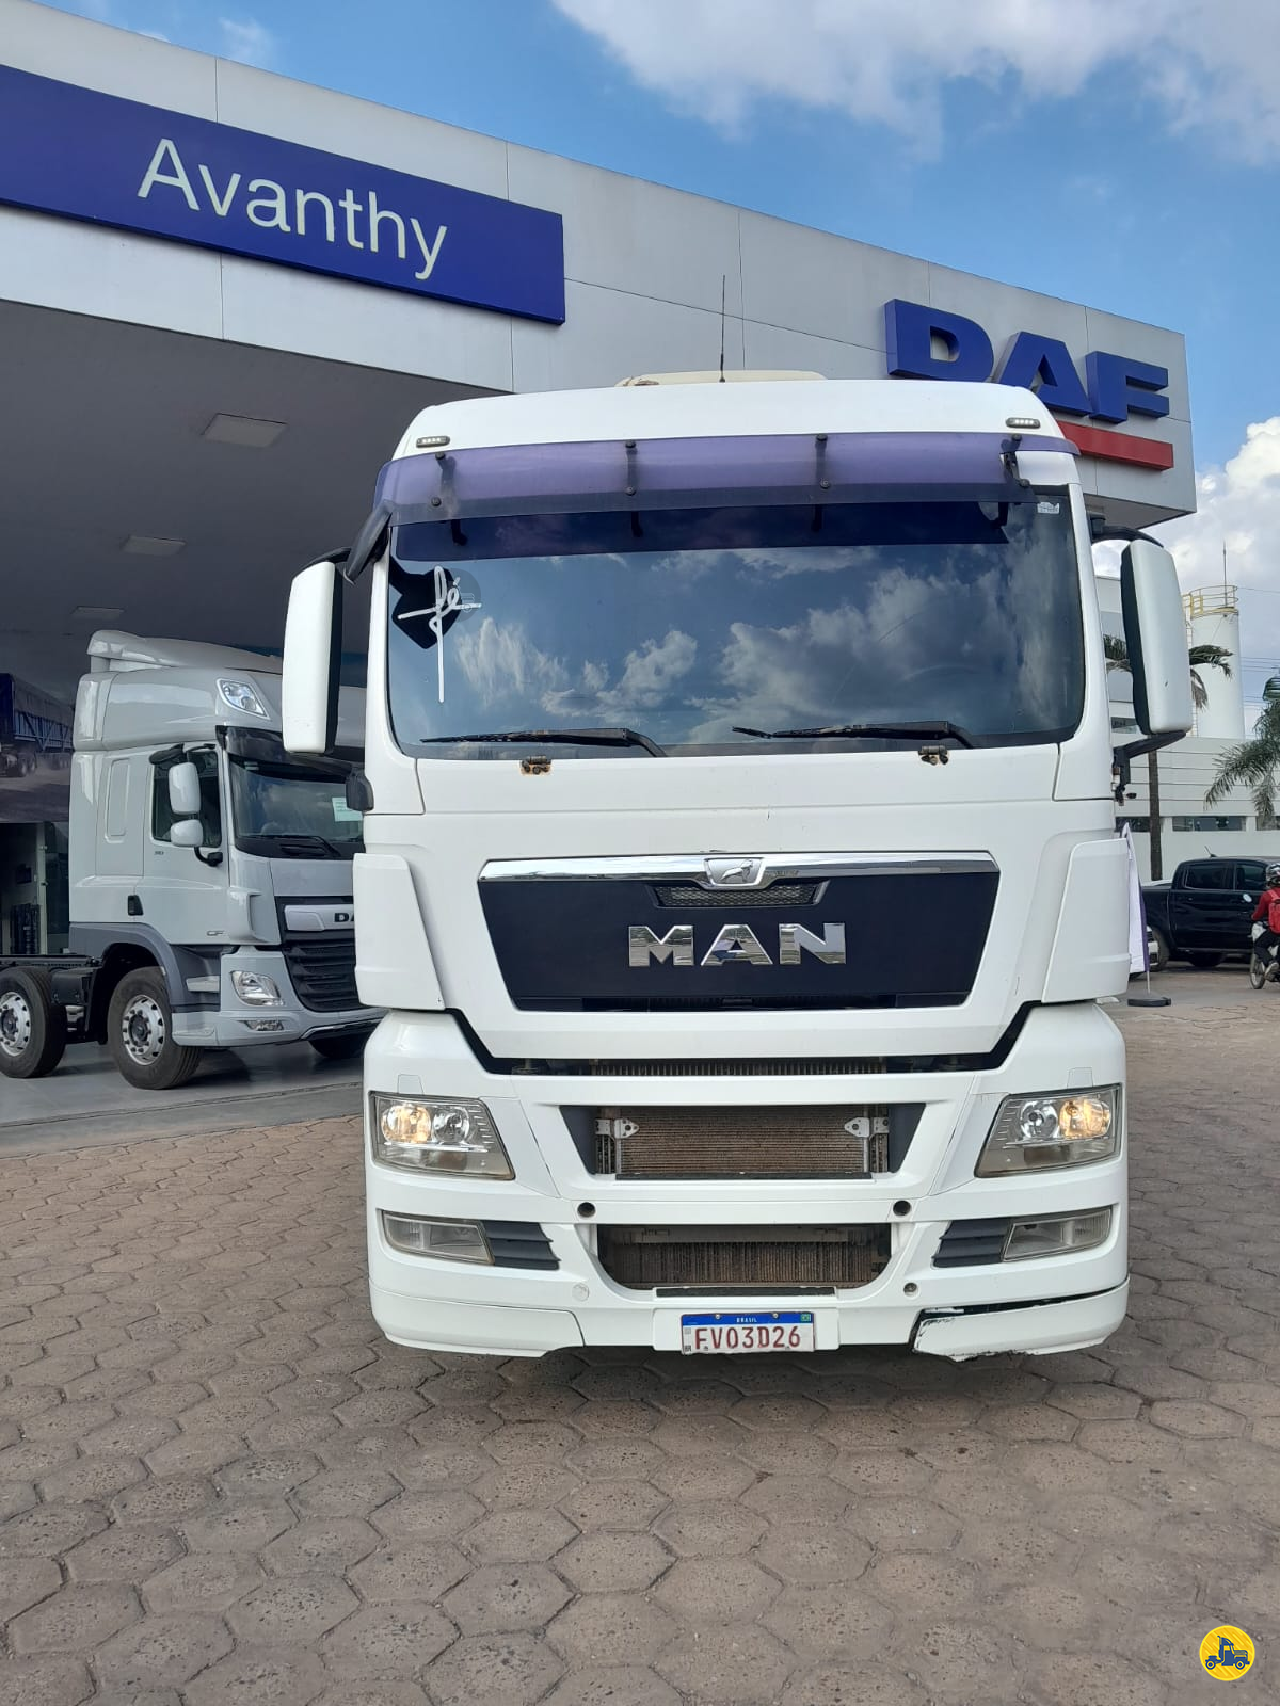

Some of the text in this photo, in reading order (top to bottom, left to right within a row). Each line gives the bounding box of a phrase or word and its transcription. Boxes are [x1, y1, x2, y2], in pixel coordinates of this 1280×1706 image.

[138, 138, 447, 280] Avanthy
[884, 298, 1170, 423] DAF
[628, 922, 846, 966] MAN
